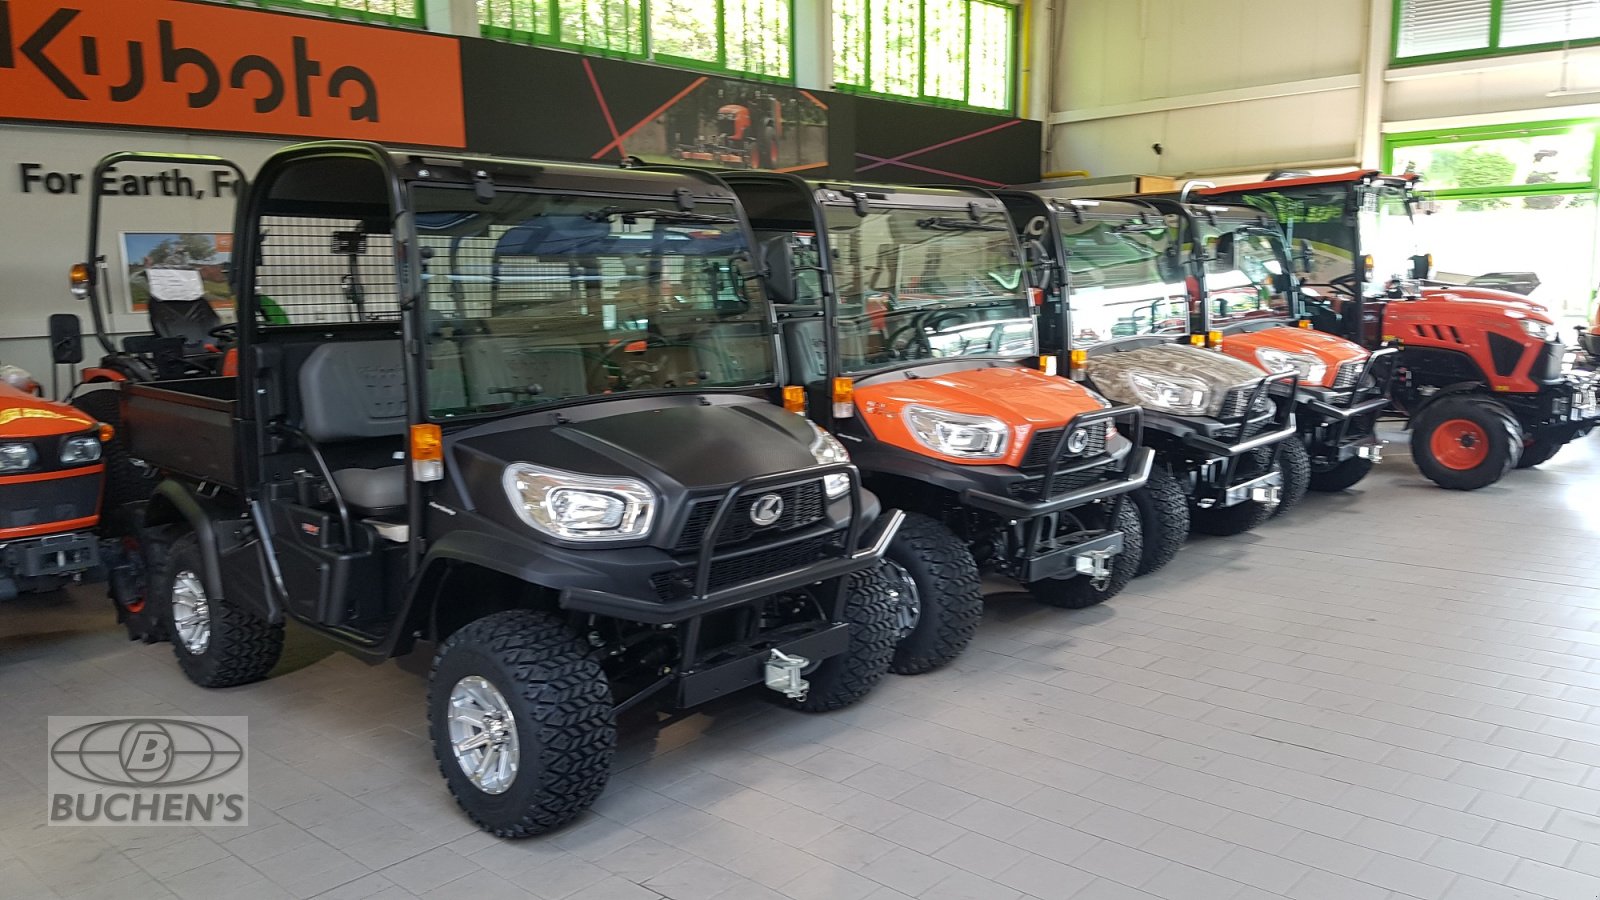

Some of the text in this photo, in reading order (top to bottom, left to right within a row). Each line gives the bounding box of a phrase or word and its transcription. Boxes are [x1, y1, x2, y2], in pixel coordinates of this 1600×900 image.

[0, 0, 379, 123] Kubota
[19, 162, 83, 194] For
[100, 166, 204, 199] Earth,
